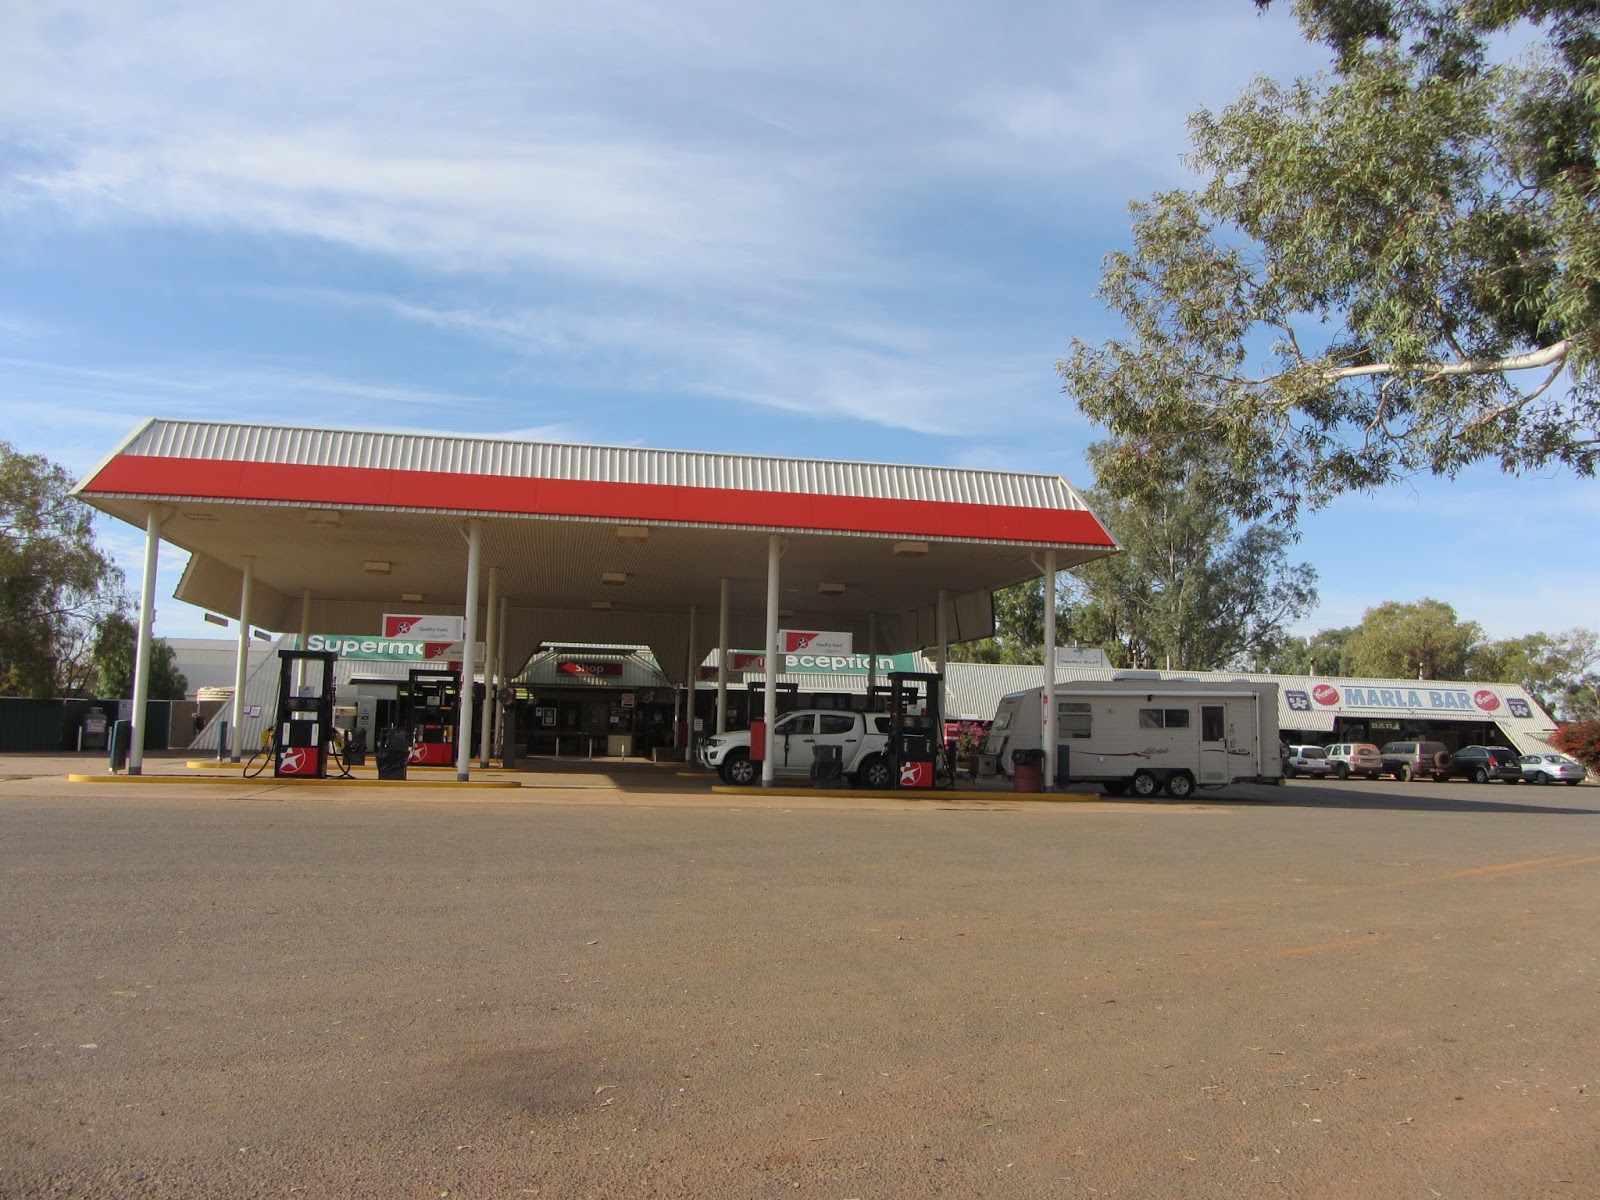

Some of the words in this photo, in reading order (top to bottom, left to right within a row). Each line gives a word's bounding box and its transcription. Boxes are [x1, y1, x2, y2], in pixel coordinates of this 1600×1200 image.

[574, 663, 604, 674] Shop
[785, 654, 895, 671] eception
[1344, 688, 1423, 707] MARLA
[1428, 691, 1474, 709] BAR
